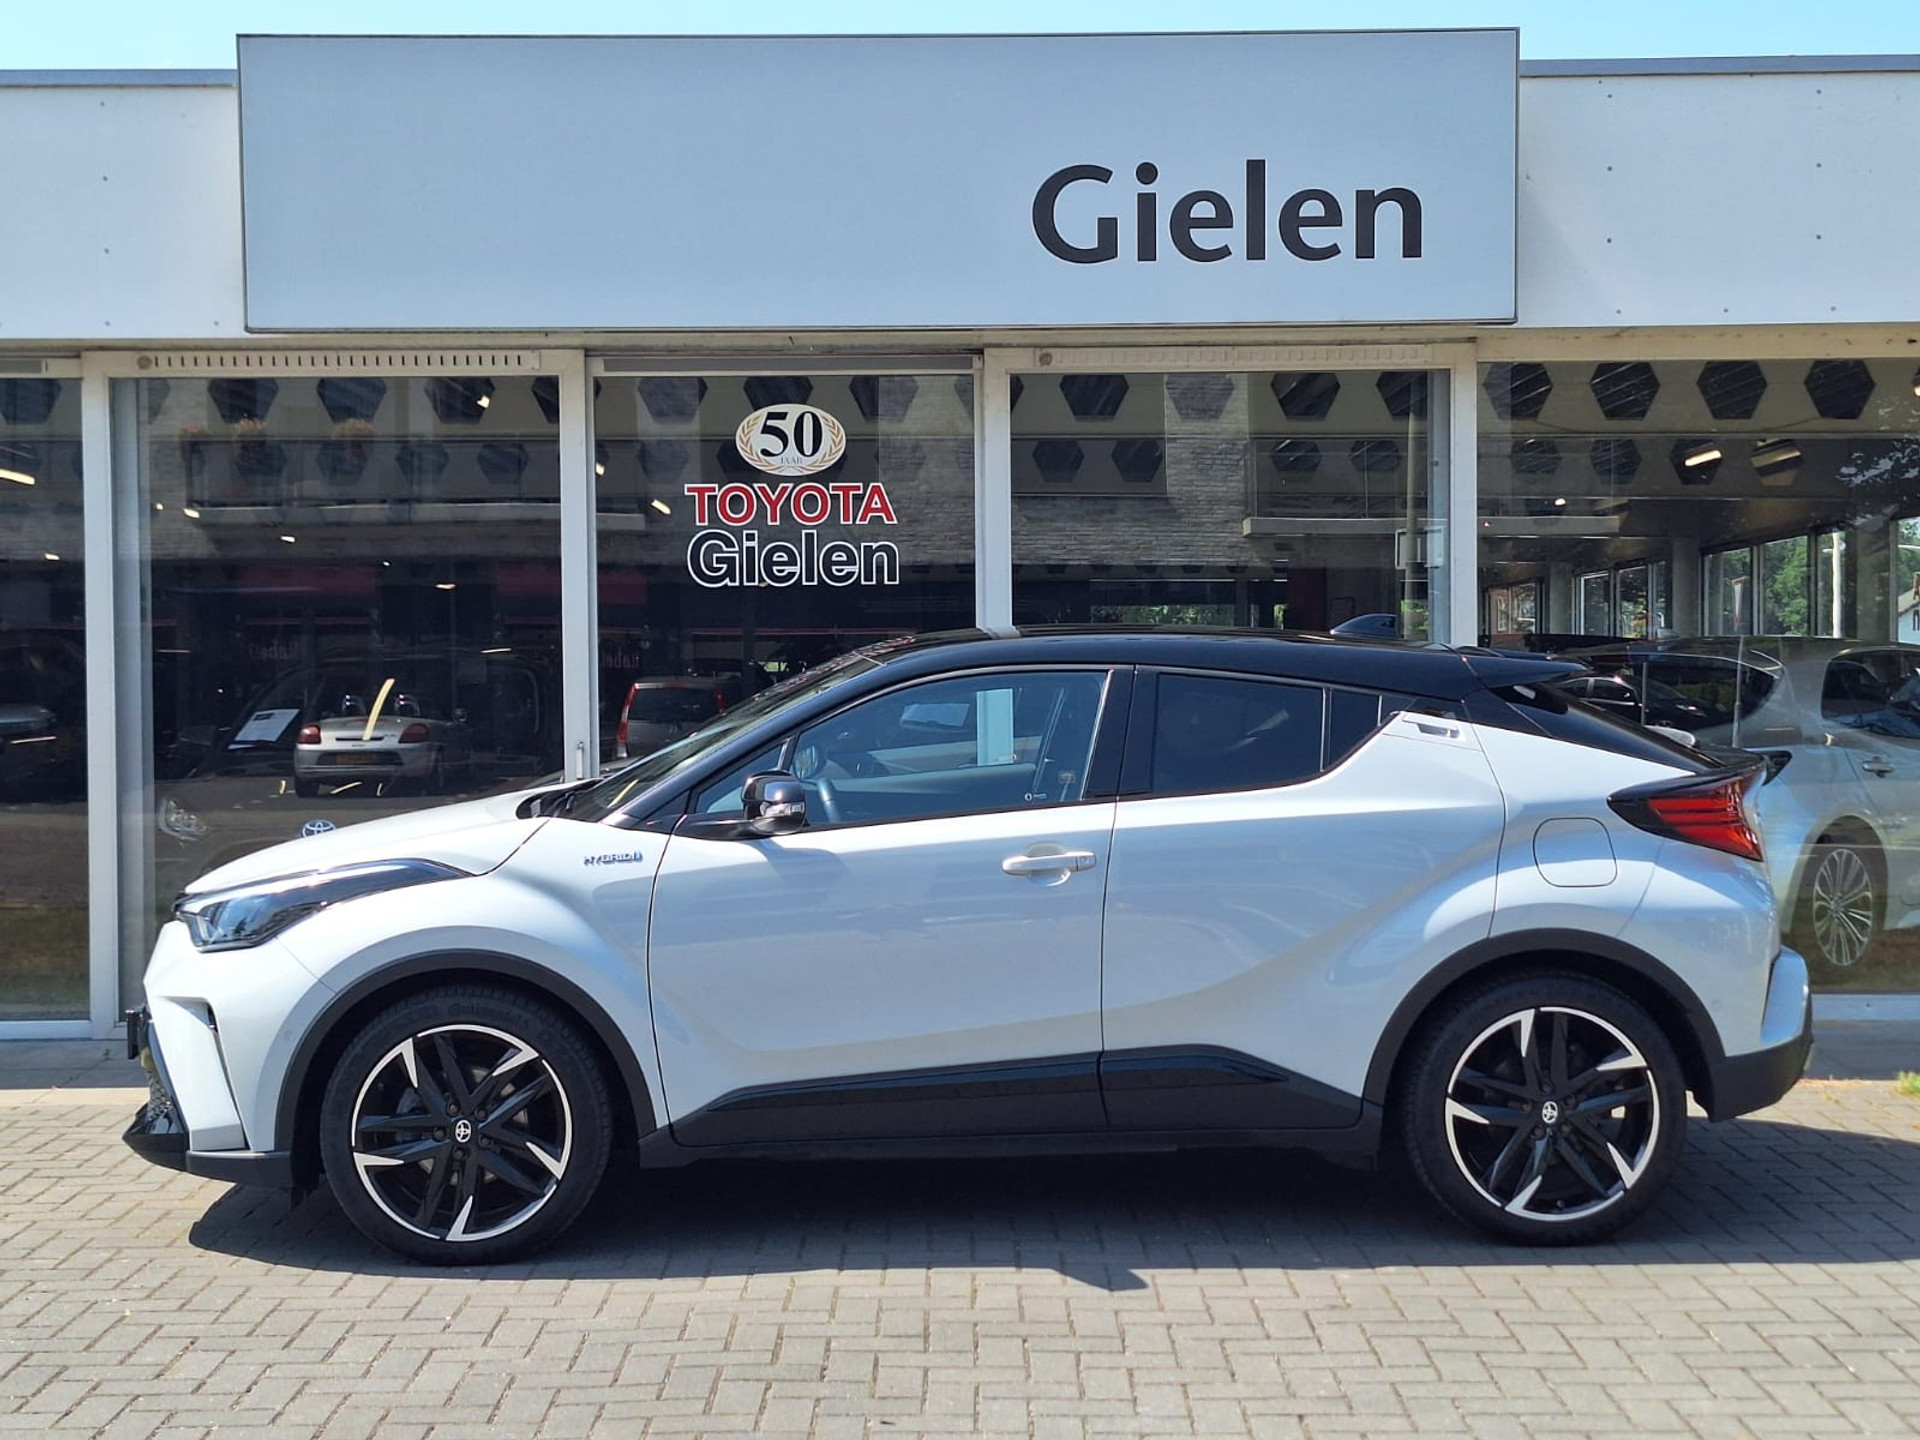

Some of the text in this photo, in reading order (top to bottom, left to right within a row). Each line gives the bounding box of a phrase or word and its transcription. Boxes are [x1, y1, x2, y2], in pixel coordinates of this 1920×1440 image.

[1032, 159, 1422, 264] Gielen
[760, 410, 823, 457] 50
[684, 482, 898, 526] TOYOTA
[687, 529, 899, 588] Gielen
